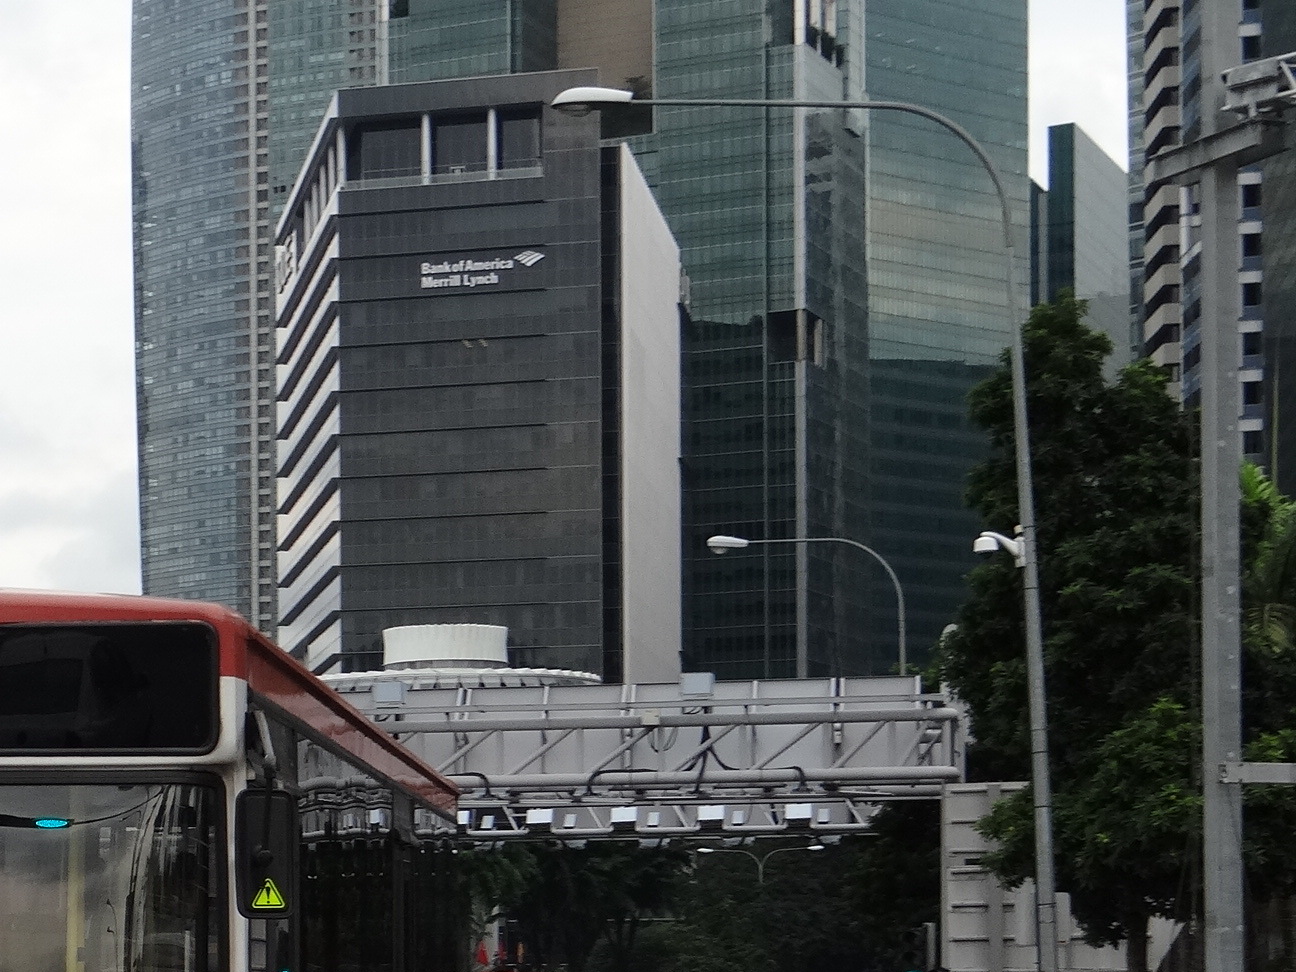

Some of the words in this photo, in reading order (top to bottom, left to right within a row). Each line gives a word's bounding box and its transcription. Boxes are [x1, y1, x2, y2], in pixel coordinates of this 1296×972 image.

[421, 261, 451, 274] Bank
[451, 259, 465, 272] of
[465, 258, 514, 271] America
[421, 274, 461, 289] Merrill
[462, 272, 499, 287] Lynch
